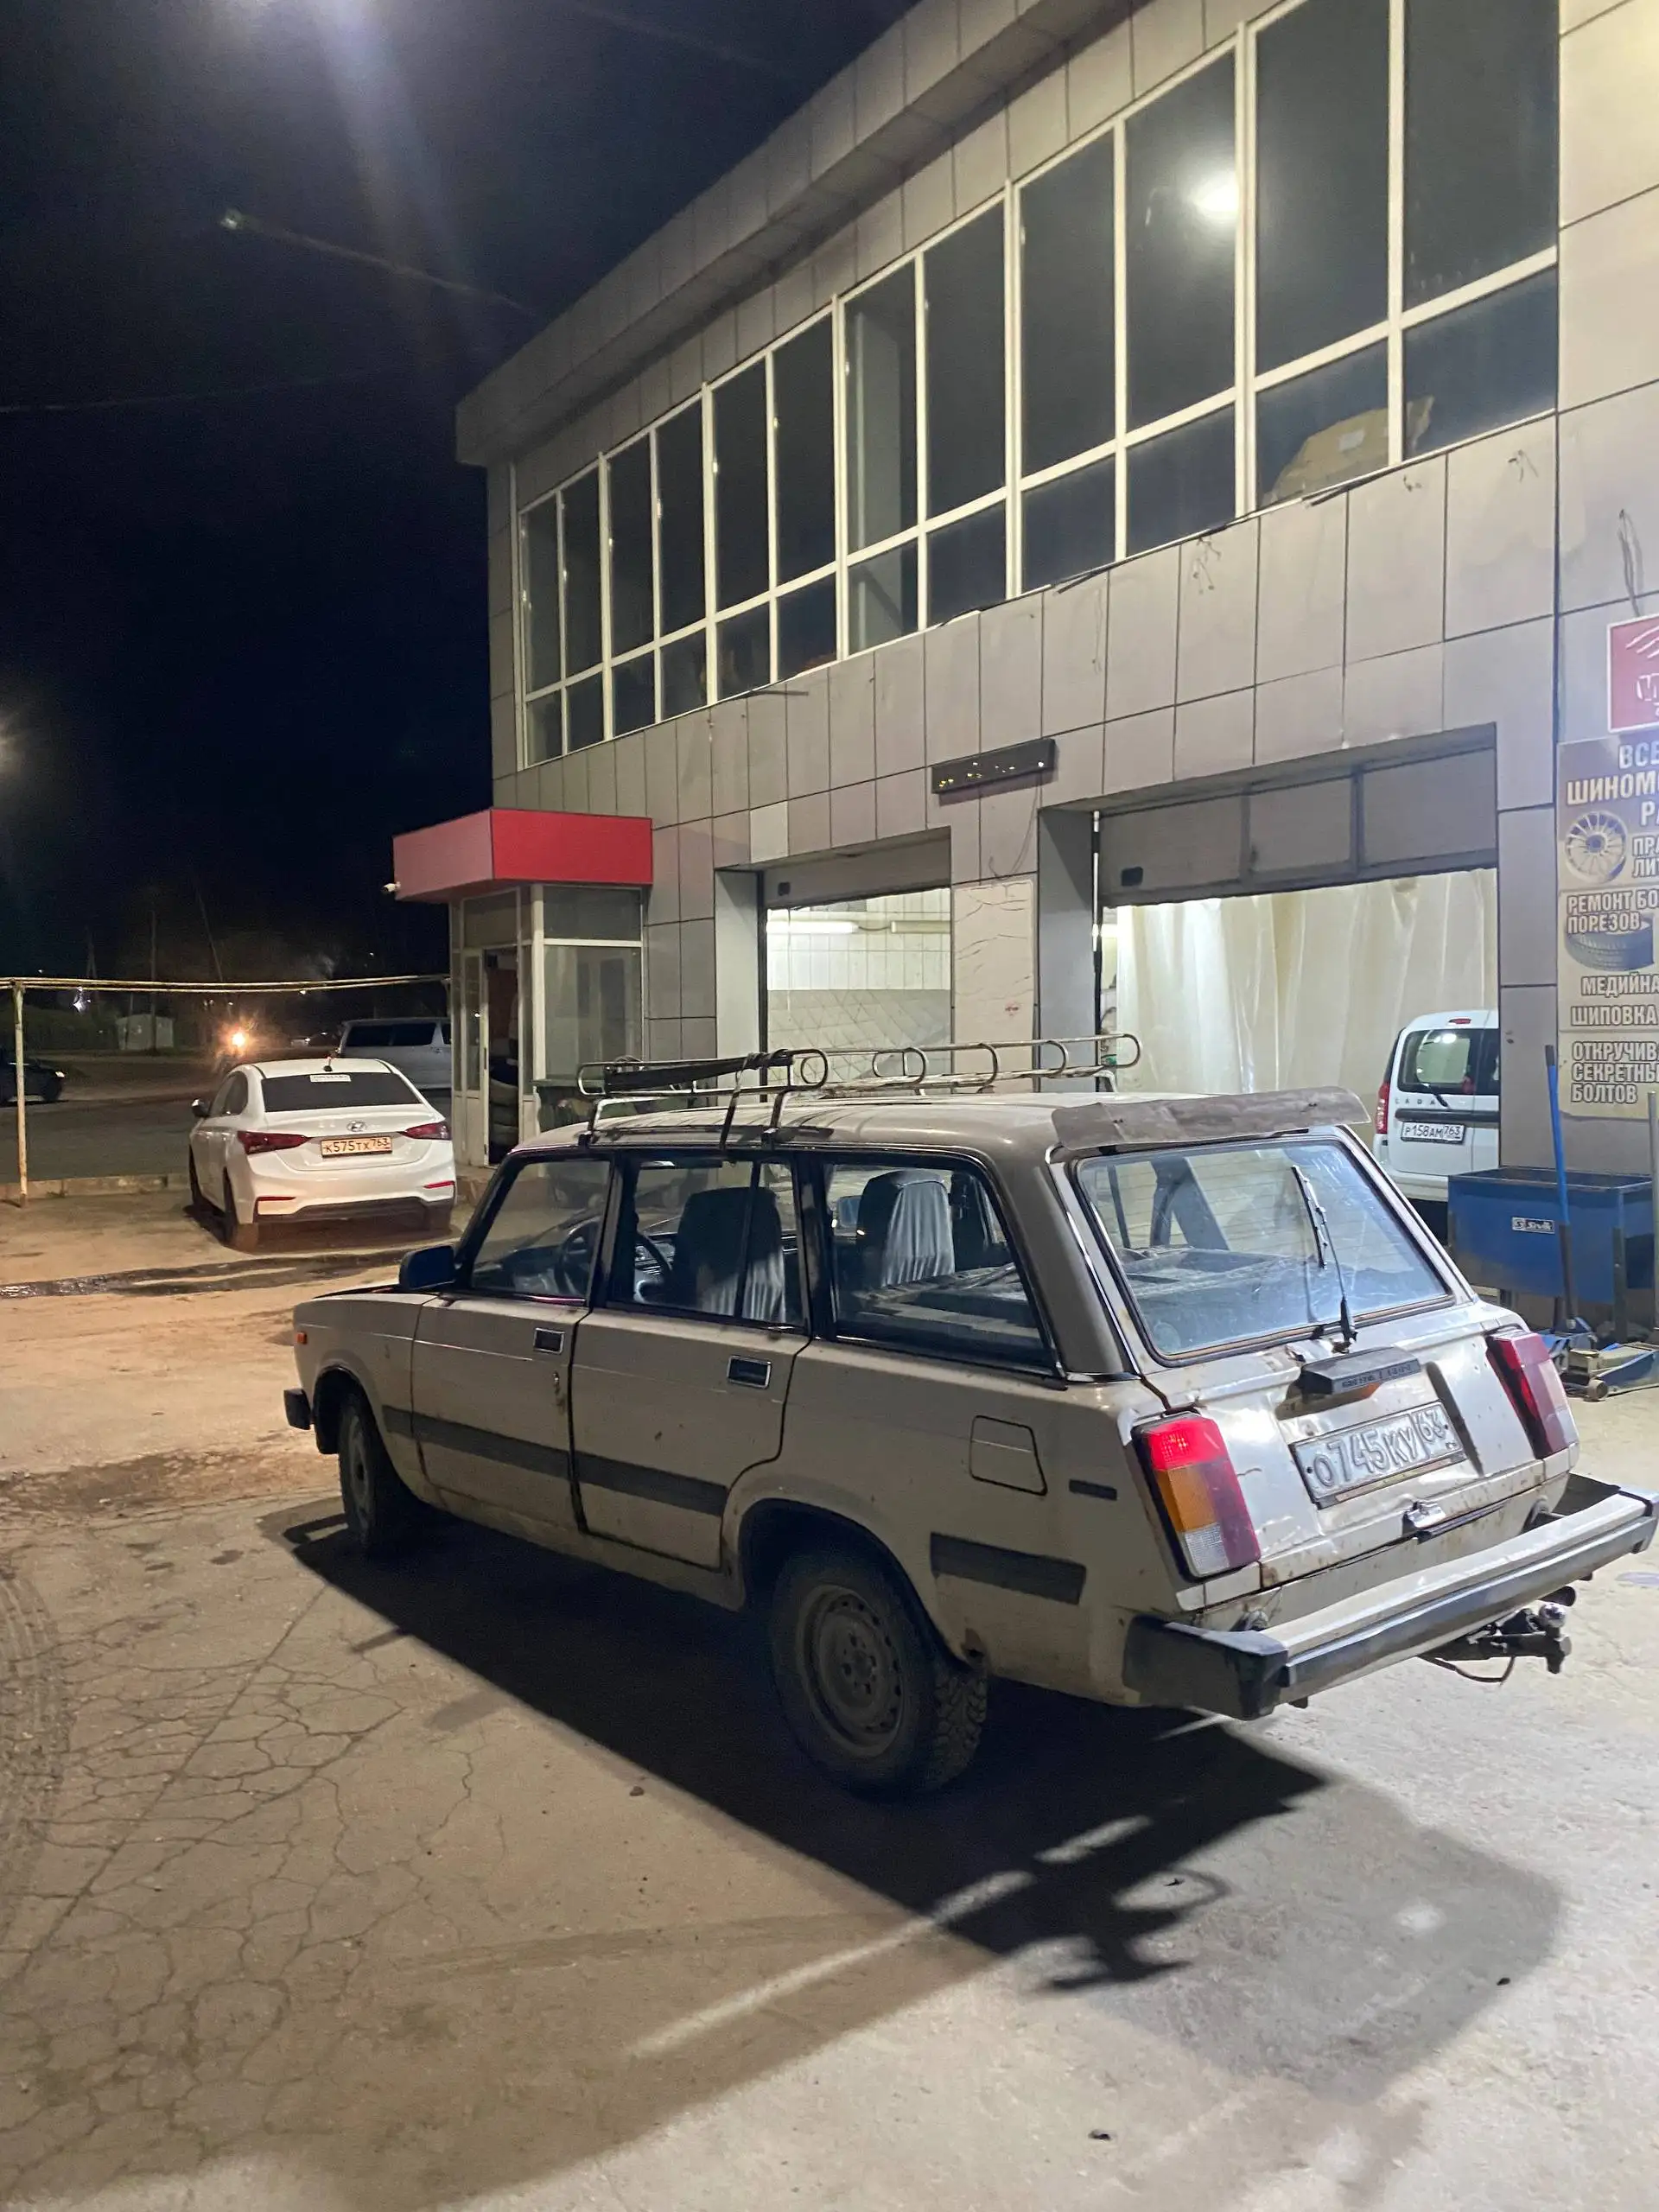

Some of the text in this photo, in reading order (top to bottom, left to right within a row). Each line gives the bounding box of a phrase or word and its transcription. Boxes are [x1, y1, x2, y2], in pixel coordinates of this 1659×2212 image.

[1567, 770, 1659, 805] ШИНОМ
[1567, 891, 1633, 914] РЕМОНТ
[1567, 912, 1641, 934] ПОРЕЗОВ
[1571, 1005, 1658, 1026] ШИПОВКА
[1572, 1041, 1659, 1061] ОТКРУЧИВ
[1571, 1083, 1638, 1103] БОЛТОВ
